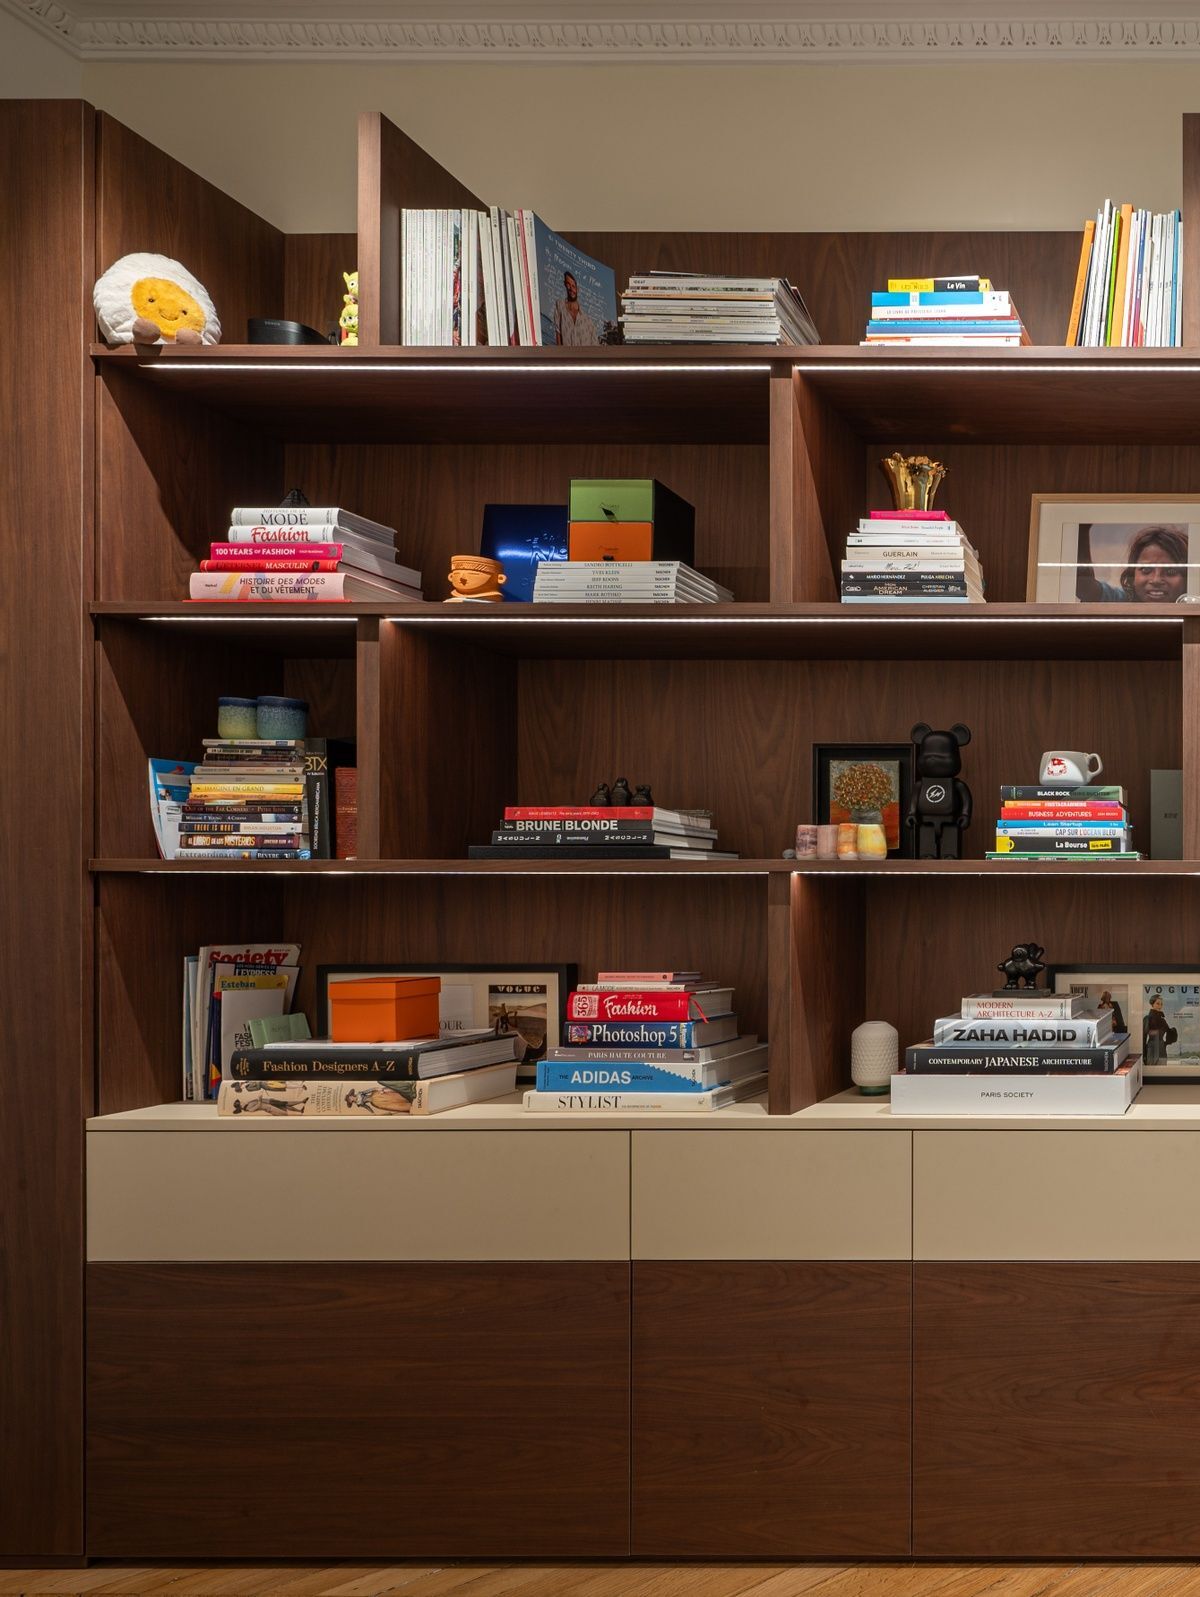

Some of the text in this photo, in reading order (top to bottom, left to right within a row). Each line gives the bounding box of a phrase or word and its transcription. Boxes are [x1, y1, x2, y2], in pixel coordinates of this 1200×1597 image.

[260, 513, 308, 525] MODE
[251, 526, 310, 542] Fashion
[516, 820, 618, 830] BRUNE BLONDE
[193, 836, 210, 846] LIBRO
[224, 837, 255, 846] MISTERIOS
[209, 949, 288, 964] Society
[578, 997, 588, 1016] 365
[603, 995, 658, 1018] Fashion
[592, 1025, 666, 1046] Photoshop
[669, 1025, 677, 1042] 5
[953, 1029, 1076, 1041] ZAHA HADID
[263, 1061, 308, 1071] Fashion
[312, 1061, 368, 1074] Designers
[984, 1057, 1039, 1068] JAPANESE
[571, 1071, 631, 1084] ADIDAS
[558, 1096, 621, 1109] STYLIST
